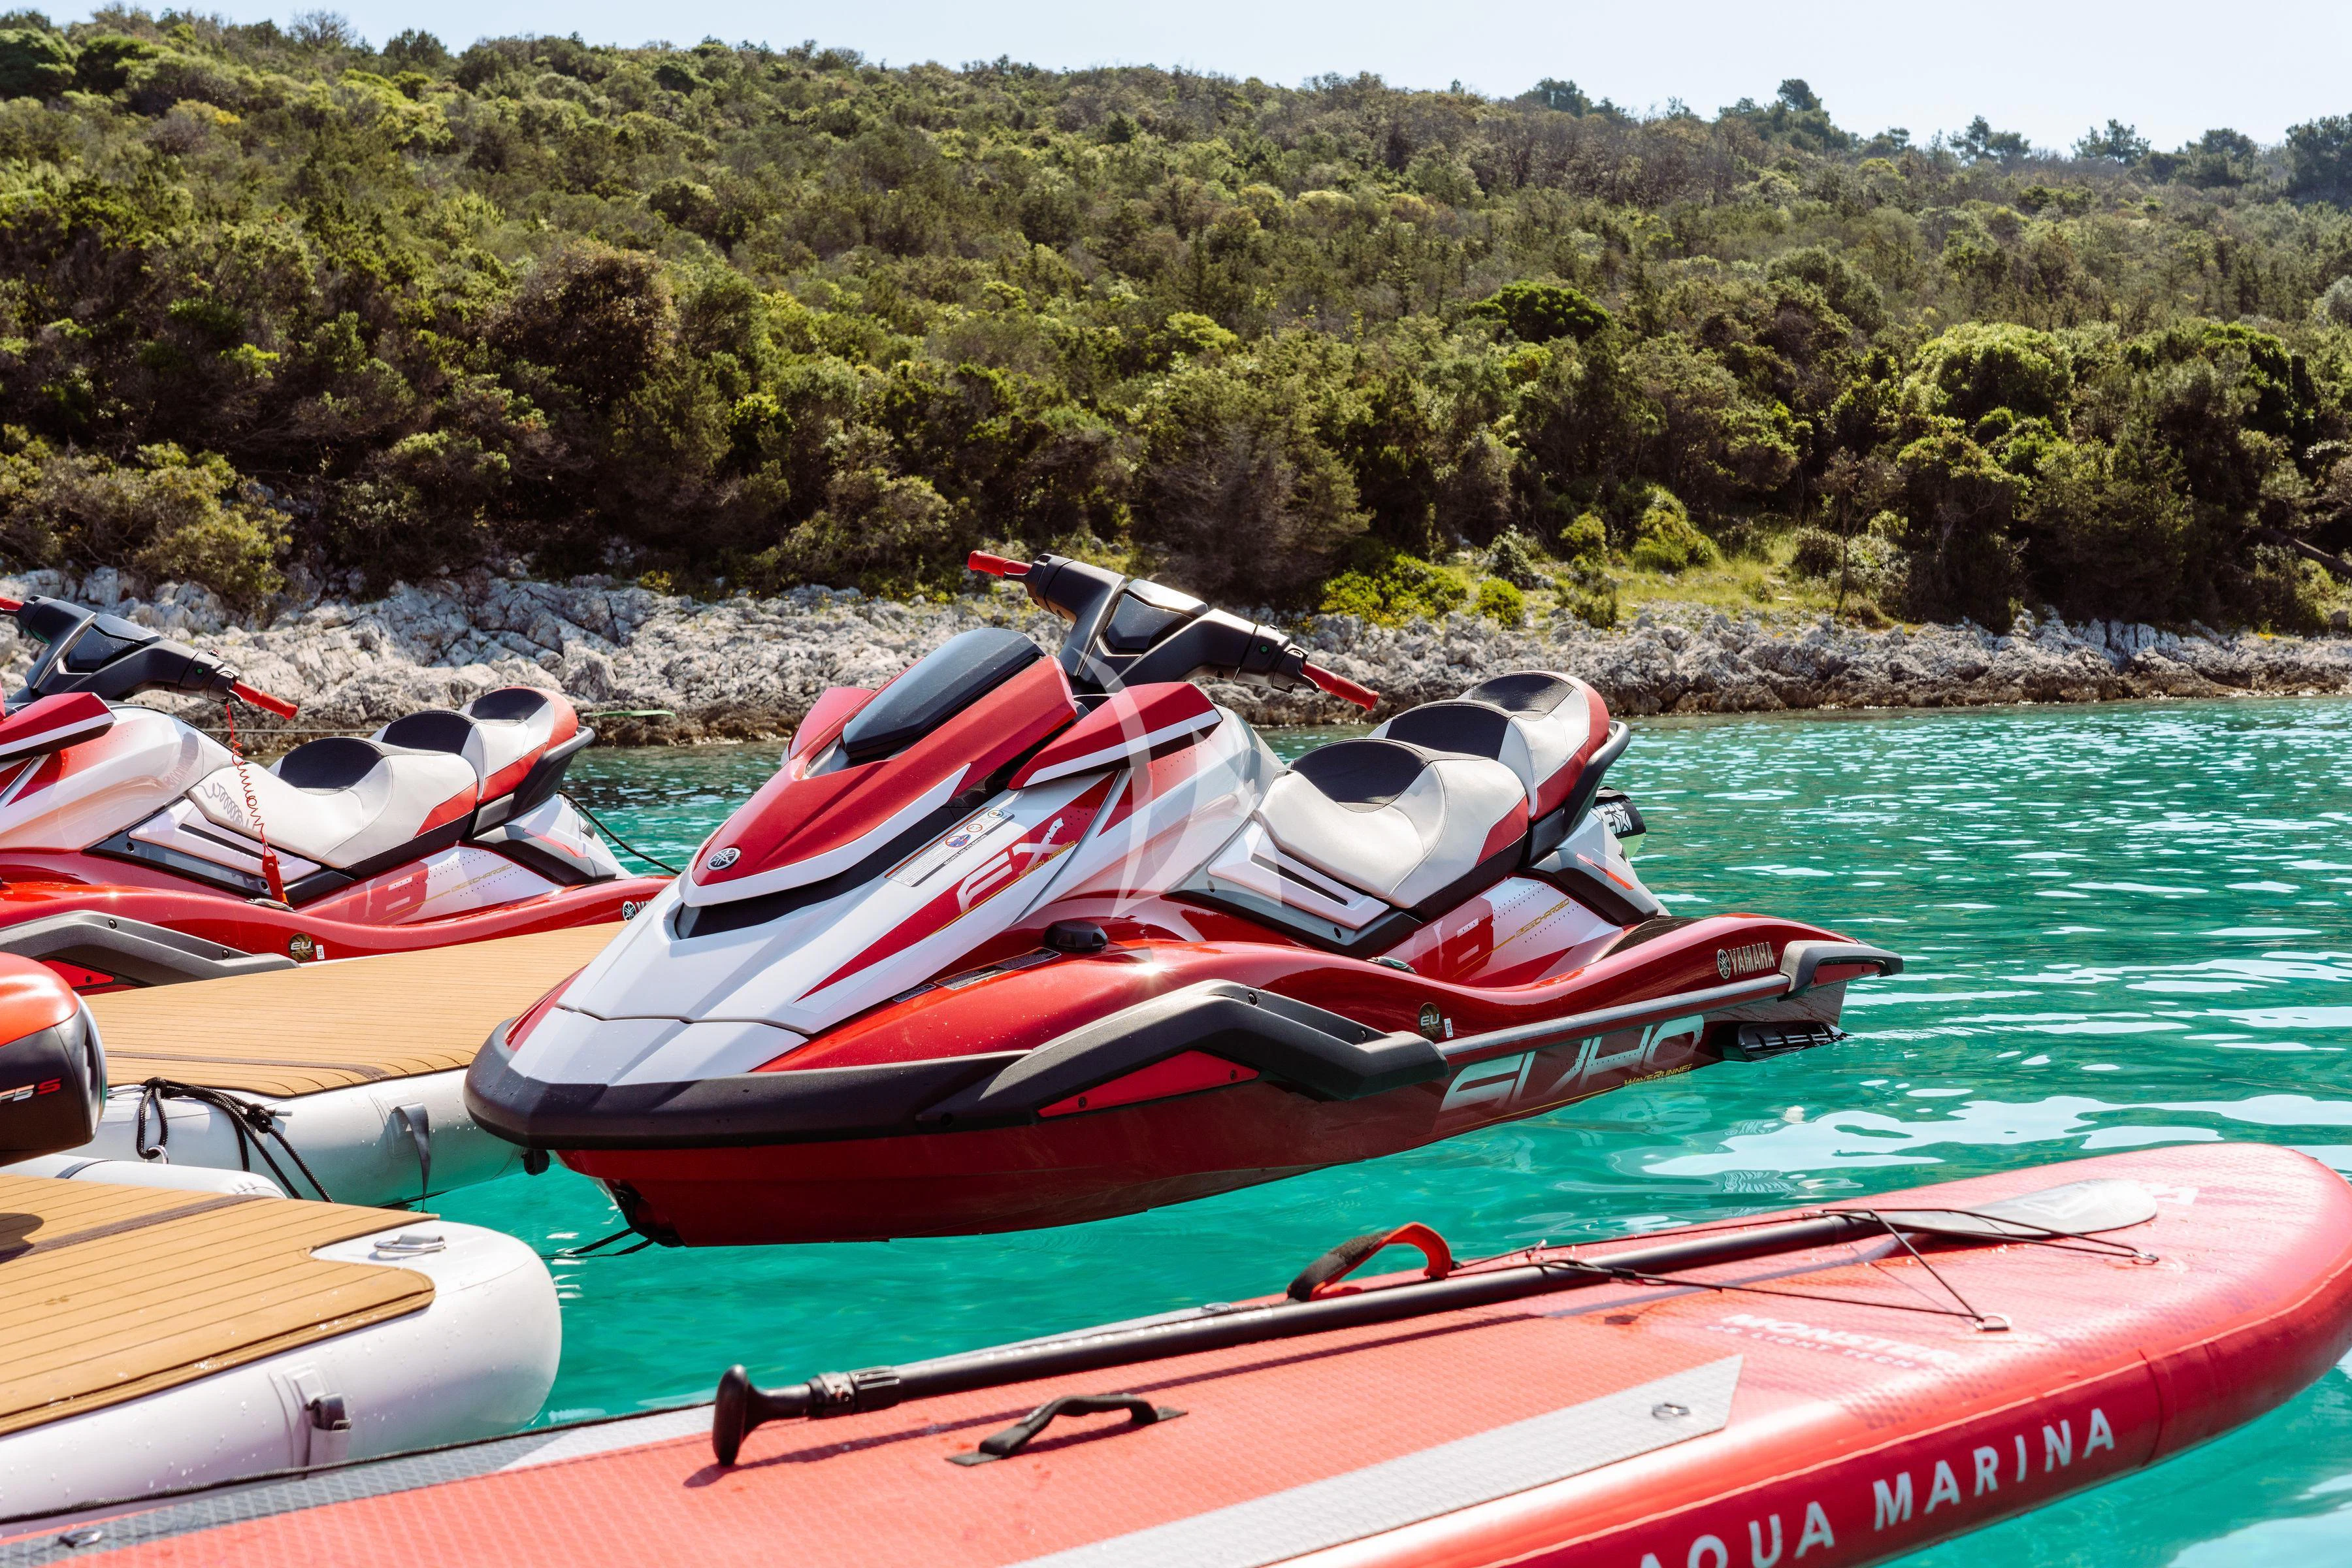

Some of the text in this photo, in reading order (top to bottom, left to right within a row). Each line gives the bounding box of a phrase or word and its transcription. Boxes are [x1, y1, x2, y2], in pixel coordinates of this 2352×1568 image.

[956, 817, 1069, 913] FX
[1025, 840, 1076, 876] CRUISER
[290, 941, 312, 951] EU
[1727, 941, 1775, 975] YAMAHA
[1420, 1013, 1439, 1026] EU
[37, 1078, 61, 1095] S
[1720, 1313, 1961, 1365] MONSTER
[1873, 1408, 2115, 1531] MARINA
